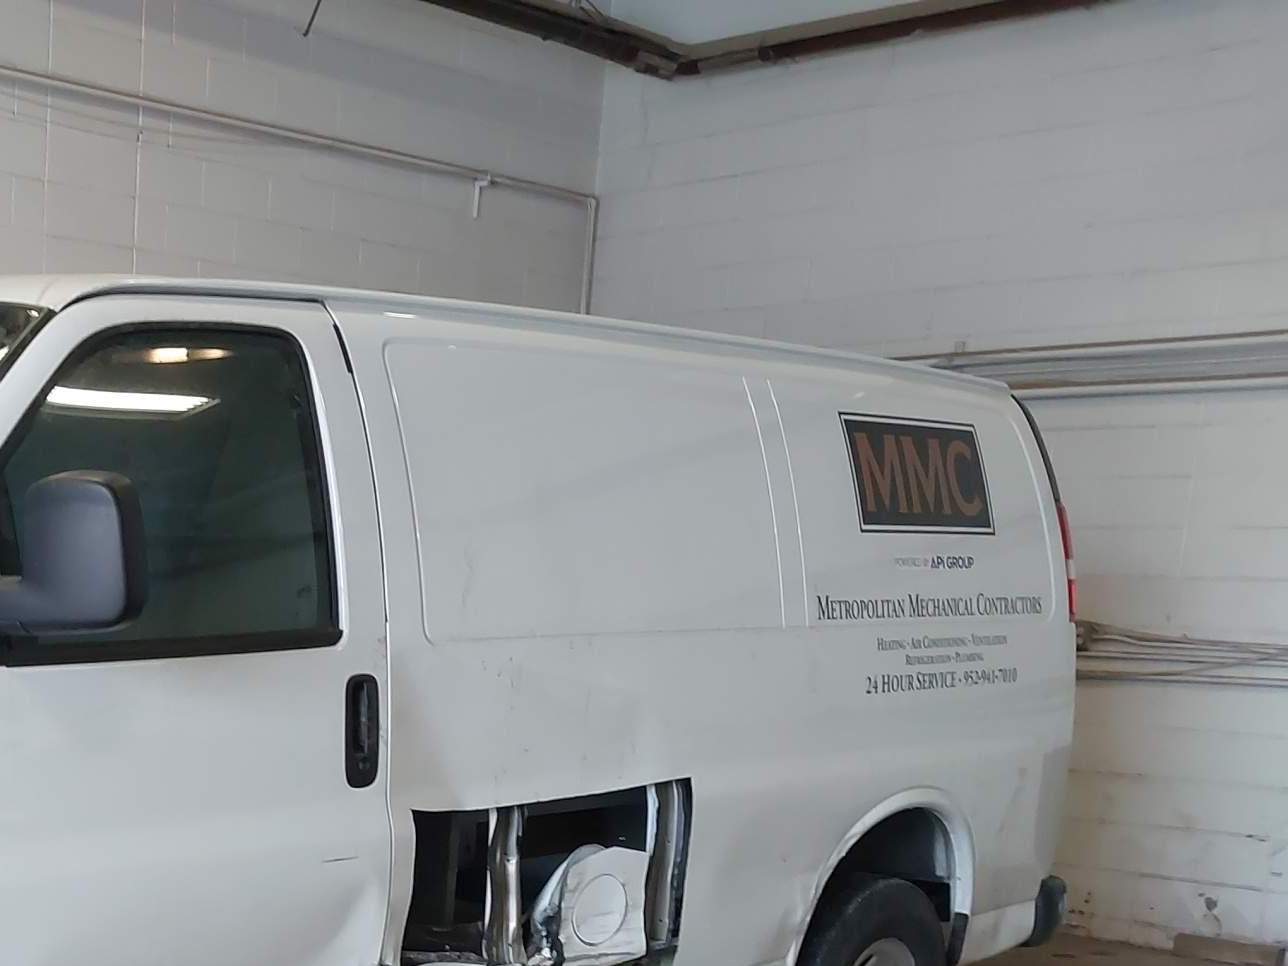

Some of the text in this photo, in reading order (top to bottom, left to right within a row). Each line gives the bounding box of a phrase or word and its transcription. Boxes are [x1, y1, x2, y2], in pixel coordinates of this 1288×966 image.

[853, 432, 984, 516] MMC
[946, 555, 975, 569] GROUP
[865, 675, 879, 695] 24
[881, 673, 915, 694] HOUR
